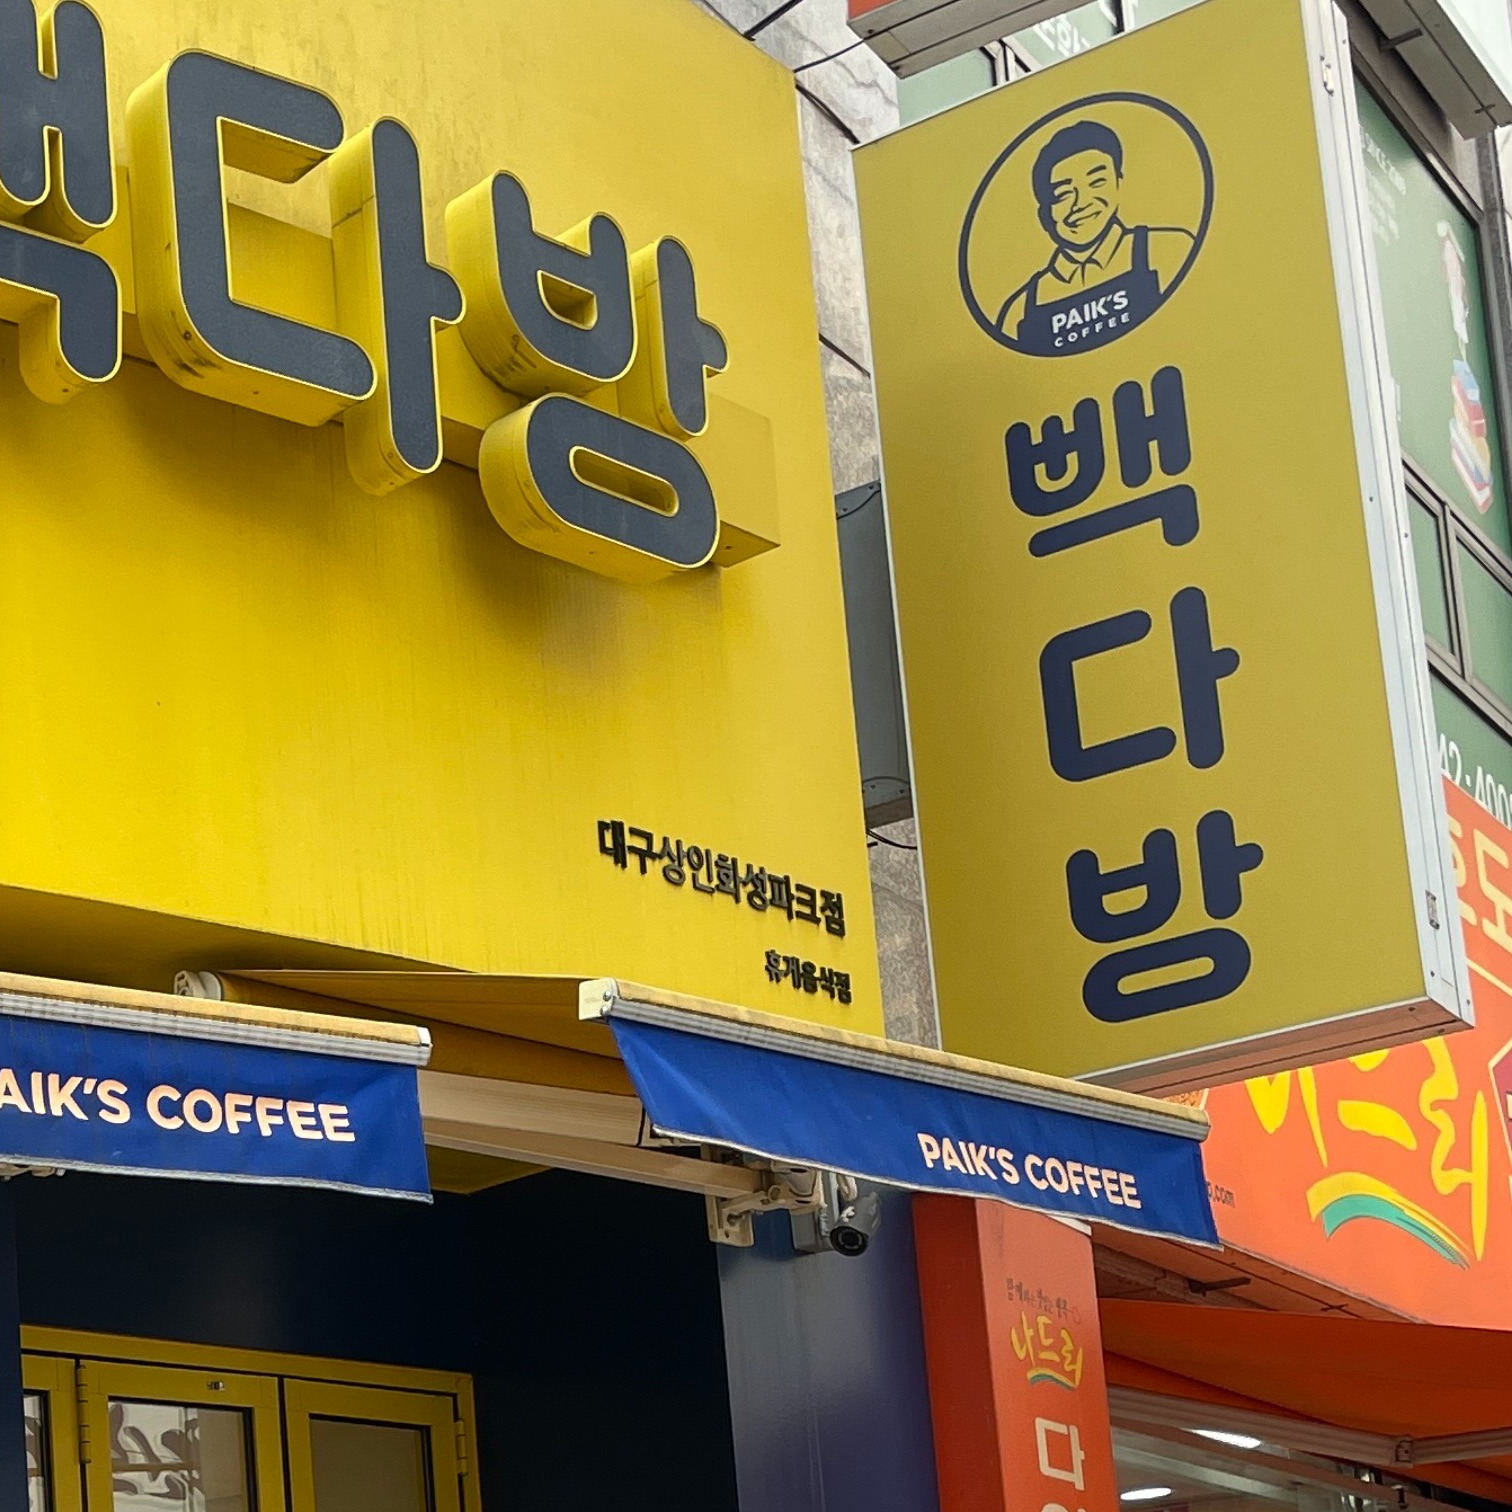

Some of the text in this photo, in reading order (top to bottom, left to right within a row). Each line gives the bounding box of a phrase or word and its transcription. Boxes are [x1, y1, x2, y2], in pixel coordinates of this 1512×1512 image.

[1050, 288, 1129, 335] PAIK'S
[1054, 311, 1131, 348] COFFEE
[1005, 365, 1264, 1023] 빽다방
[597, 820, 846, 938] 대구상인화성파크점
[764, 949, 852, 1004] 휴게음식점
[145, 1083, 356, 1143] COFFEE
[916, 1131, 1141, 1210] PAIK'S COFFEE
